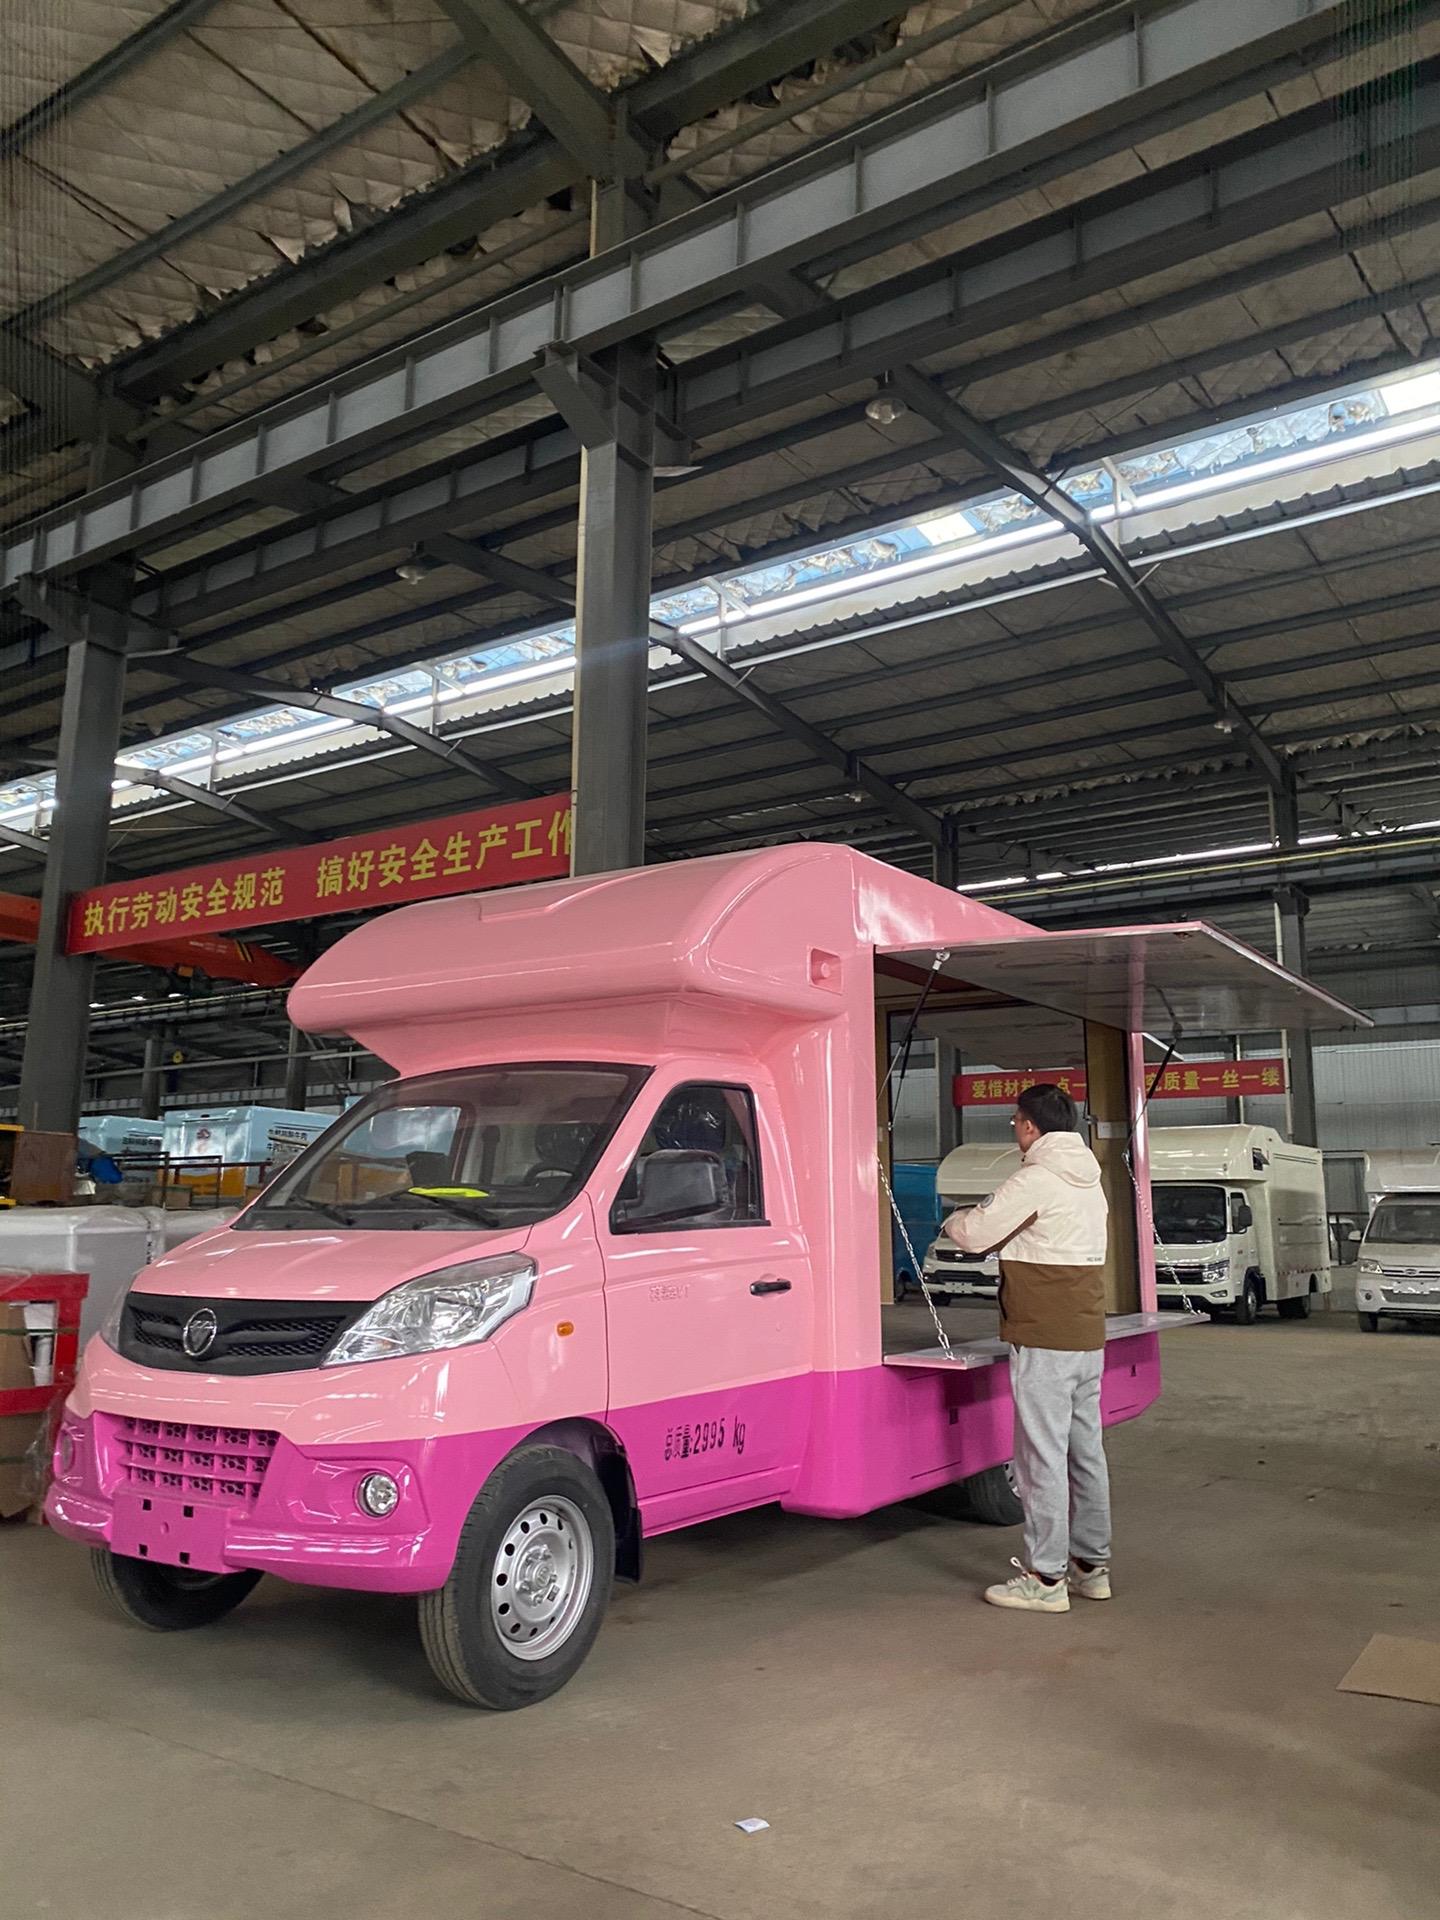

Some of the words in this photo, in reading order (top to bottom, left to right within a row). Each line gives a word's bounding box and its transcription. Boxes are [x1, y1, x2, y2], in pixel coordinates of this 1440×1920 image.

[83, 867, 287, 938] 执行劳动安全规范
[315, 808, 571, 899] 搞好安全生产工作
[732, 1414, 746, 1456] kg
